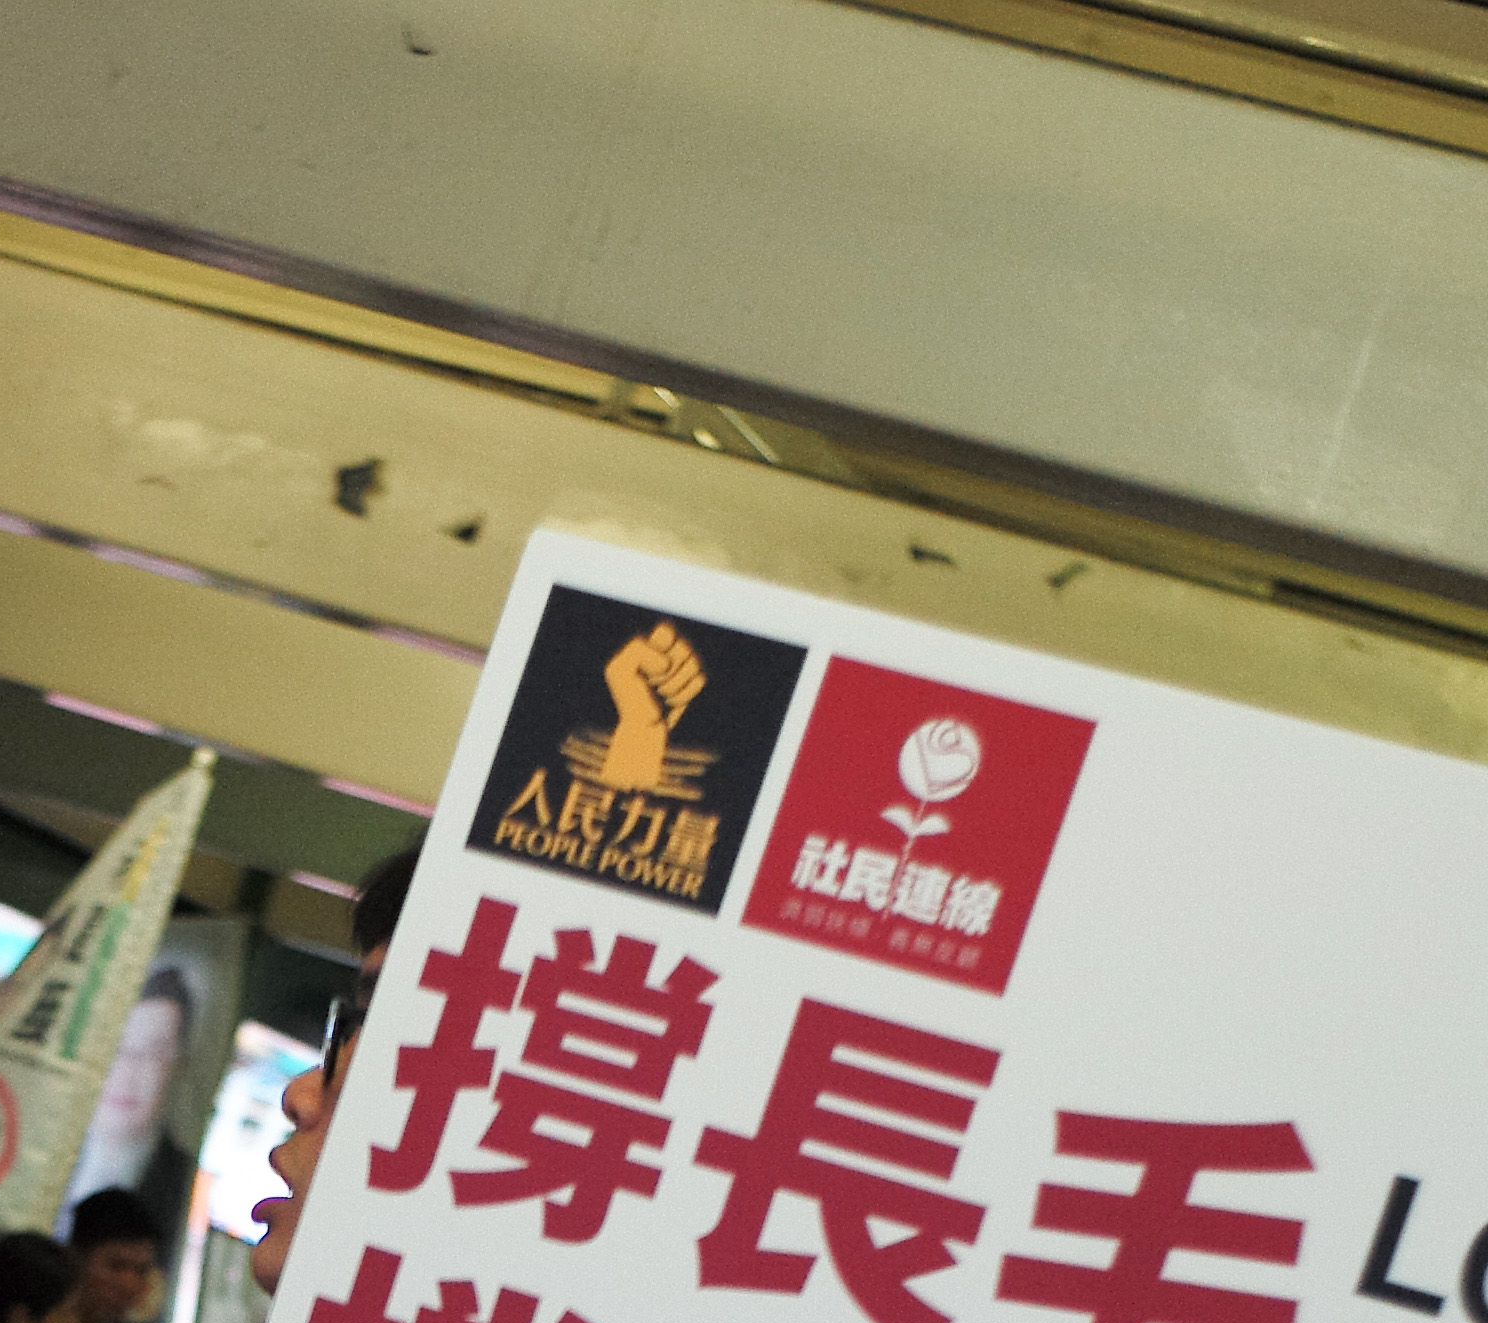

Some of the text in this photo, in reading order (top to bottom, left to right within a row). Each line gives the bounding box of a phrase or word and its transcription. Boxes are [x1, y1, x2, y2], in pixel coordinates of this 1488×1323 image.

[494, 818, 705, 900] PEOPLE POWER
[504, 767, 720, 869] 人民力量
[790, 833, 1003, 937] 社民連線
